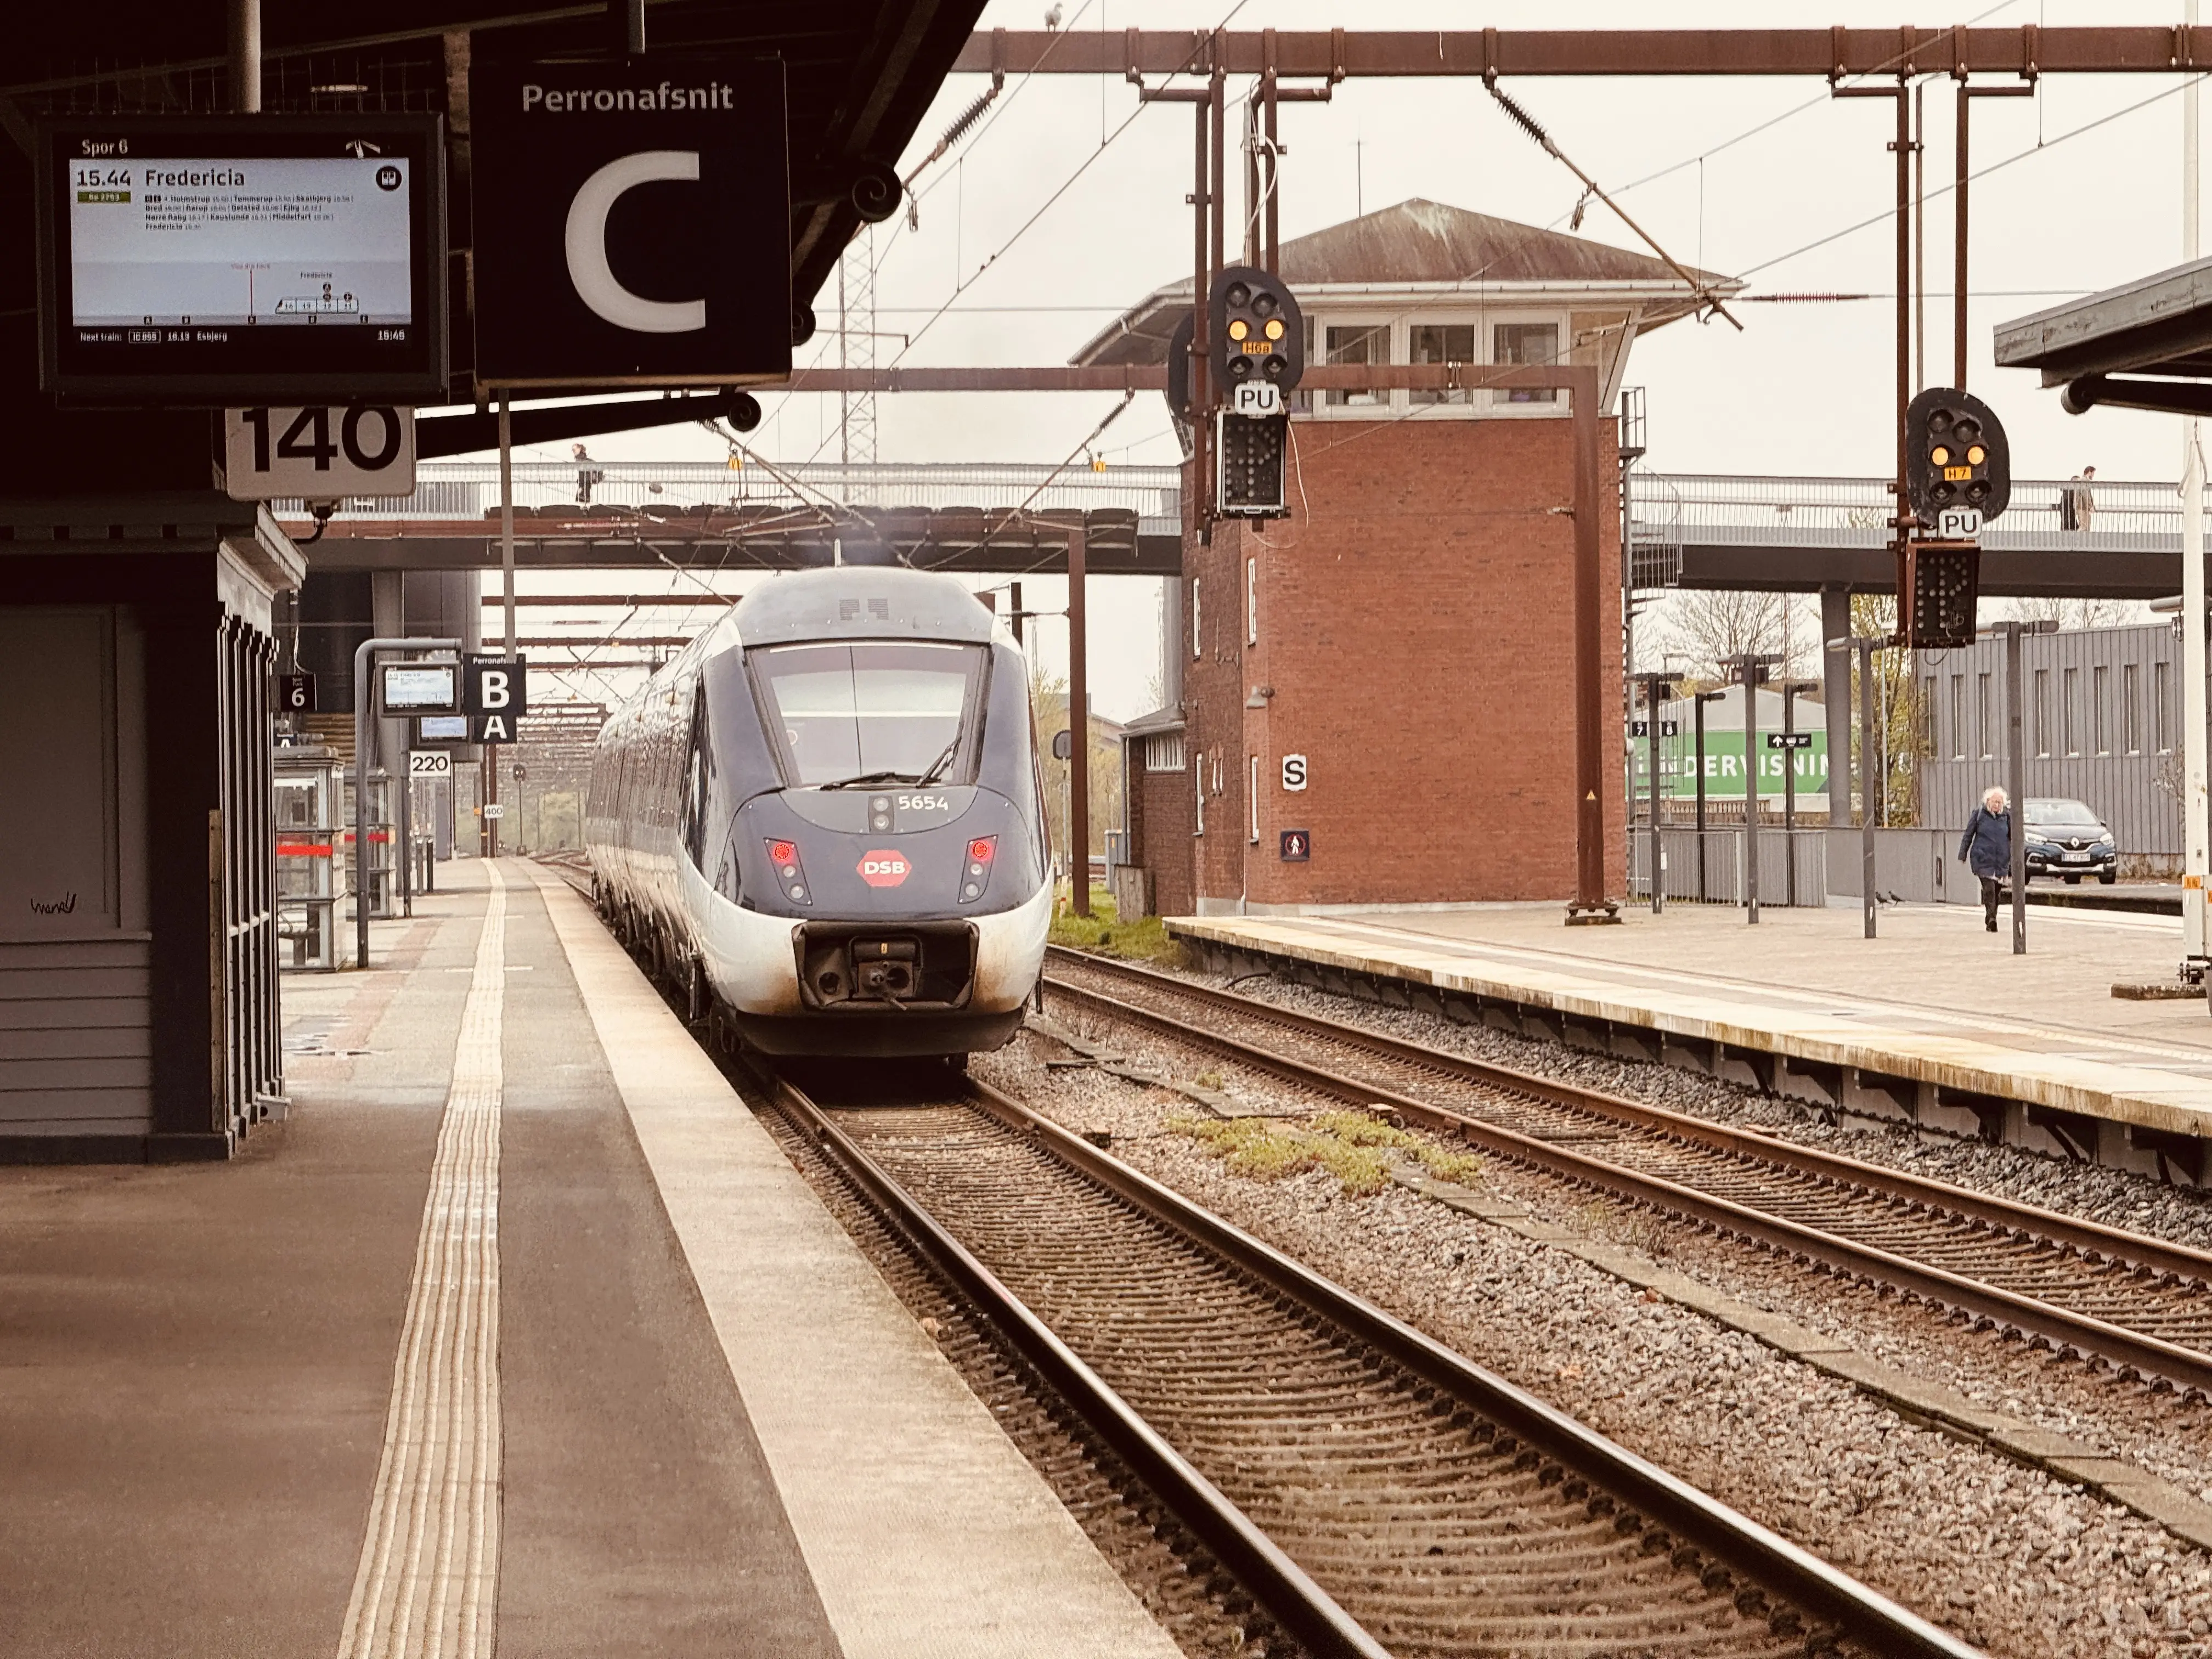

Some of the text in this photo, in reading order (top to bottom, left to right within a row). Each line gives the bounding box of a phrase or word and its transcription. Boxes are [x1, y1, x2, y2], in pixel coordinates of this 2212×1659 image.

[522, 81, 734, 111] Perronafsnit
[82, 138, 128, 157] Spor 6
[76, 169, 131, 187] 15.44
[145, 168, 245, 187] Fredericia
[565, 149, 706, 334] C
[80, 331, 99, 342] Next
[197, 331, 228, 342] Esbjerg
[1240, 390, 1274, 409] PU
[242, 406, 402, 472] 140
[1945, 515, 1977, 534] PU
[291, 687, 305, 707] 6
[482, 670, 510, 709] B
[483, 715, 507, 740] A
[412, 756, 449, 772] 220
[1284, 760, 1305, 786] S
[484, 807, 503, 816] 400
[898, 795, 949, 811] 5654
[864, 861, 906, 875] DSB
